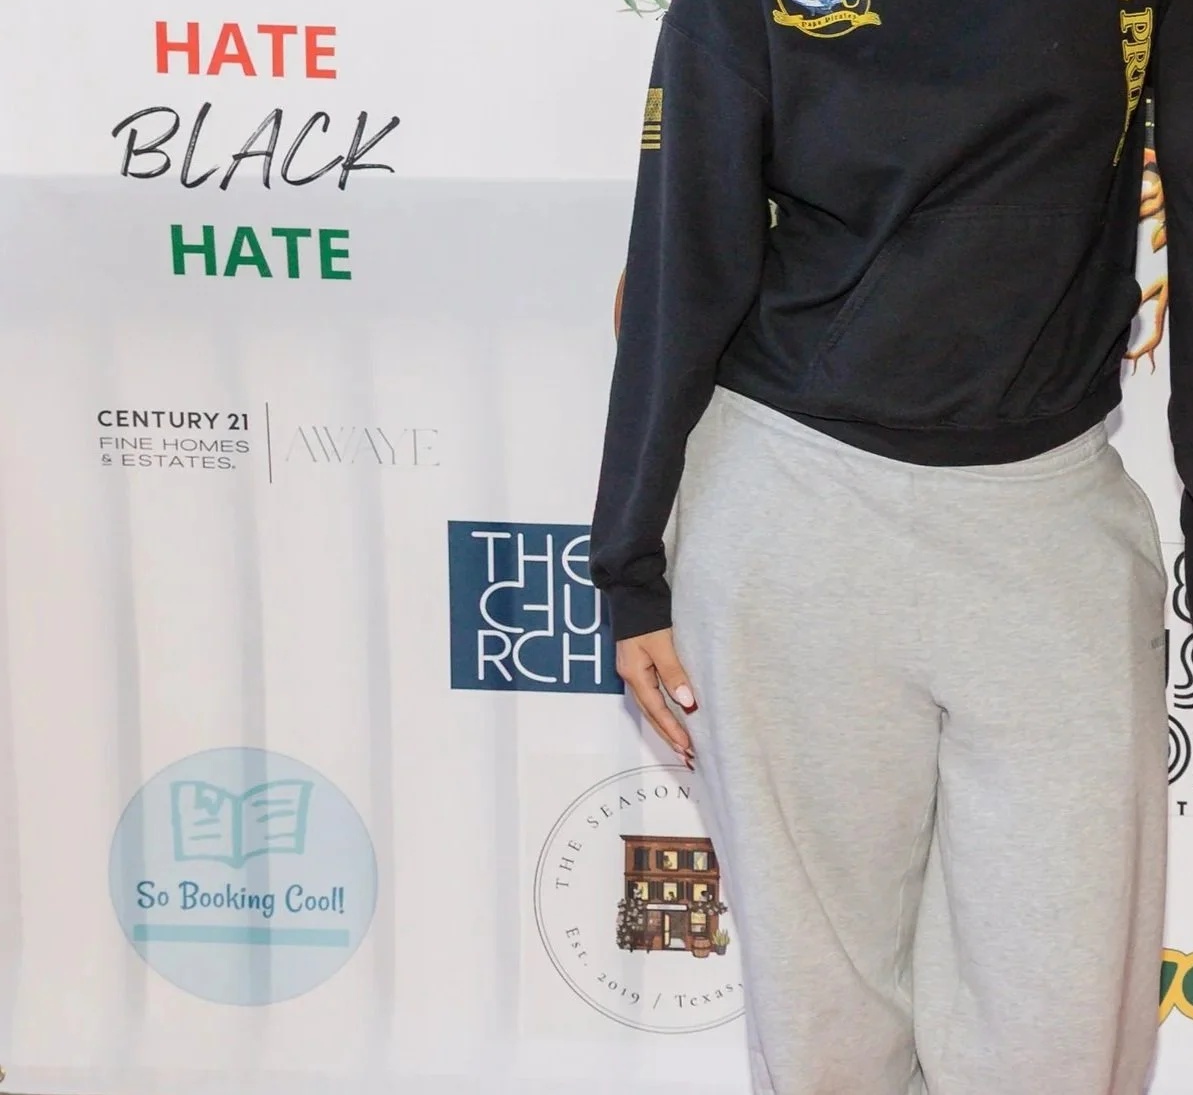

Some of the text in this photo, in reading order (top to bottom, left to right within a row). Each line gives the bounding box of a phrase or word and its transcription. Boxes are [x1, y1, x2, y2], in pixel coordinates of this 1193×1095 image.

[155, 21, 337, 80] HATE
[111, 101, 401, 191] BLACK
[170, 224, 352, 280] HATE
[97, 410, 250, 431] CENTURY 21
[99, 437, 250, 453] FINE HOMES
[286, 425, 440, 466] AWAYE
[471, 531, 592, 586] THE
[556, 785, 698, 889] THE SEASON
[137, 881, 344, 918] So Booking Cool!
[566, 926, 588, 966] Est.
[597, 973, 640, 1004] 2019
[674, 984, 743, 1008] Texas
